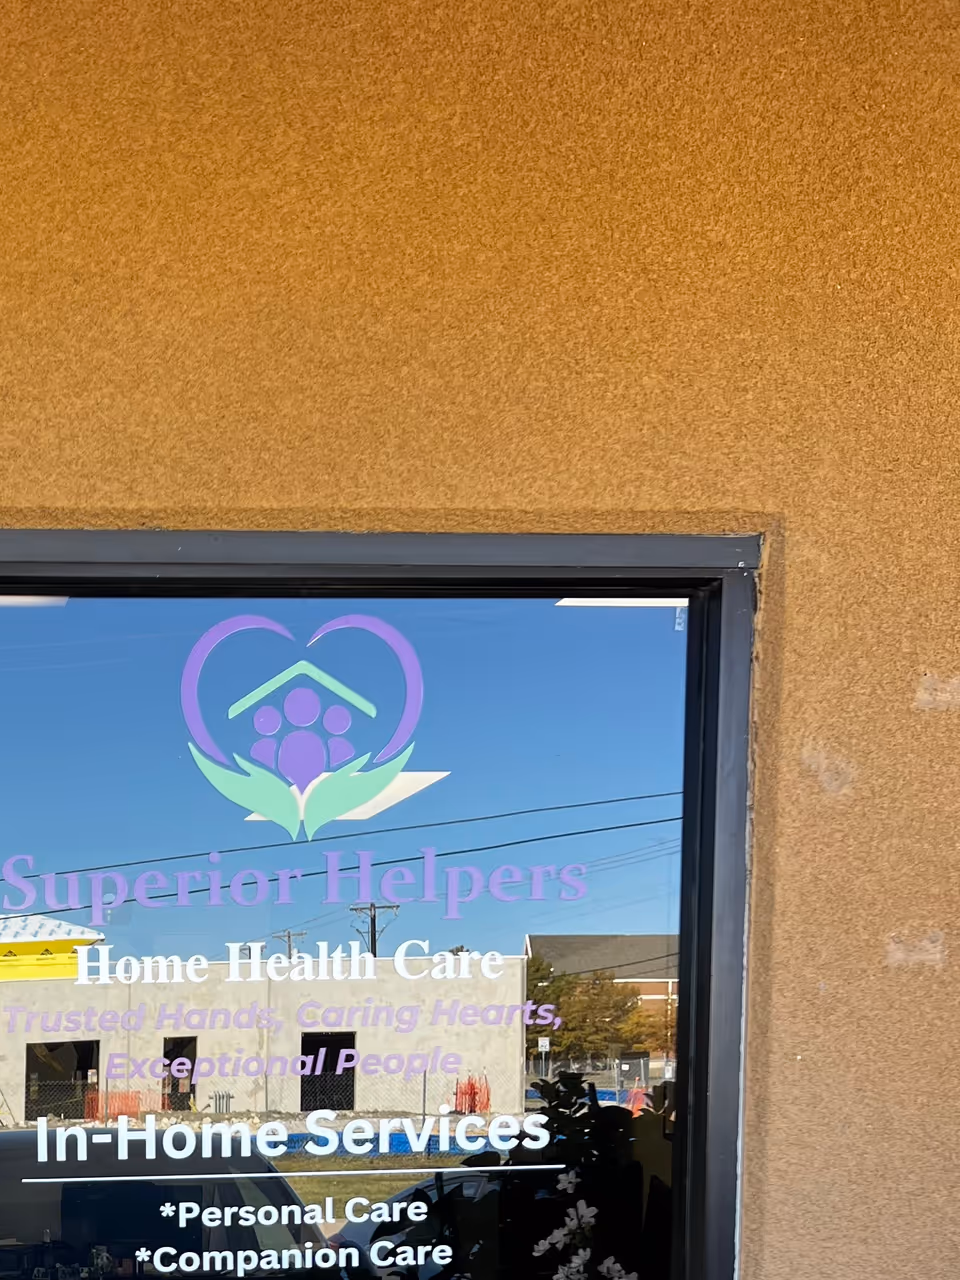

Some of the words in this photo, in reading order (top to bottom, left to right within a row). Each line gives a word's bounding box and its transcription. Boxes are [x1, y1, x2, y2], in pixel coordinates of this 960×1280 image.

[1, 850, 302, 928] Superior
[323, 846, 589, 919] Helpers
[74, 943, 209, 986] Home
[224, 940, 376, 983] Health
[393, 939, 504, 981] Care
[3, 1005, 147, 1035] Trusted
[156, 1003, 285, 1037] Hands,
[296, 1001, 421, 1037] Caring
[430, 999, 564, 1031] Hearts,
[105, 1047, 327, 1085] Exceptional
[335, 1047, 463, 1081] People
[36, 1114, 288, 1163] In-Home
[304, 1104, 551, 1157] Services
[344, 1195, 429, 1224] Care
[369, 1239, 453, 1268] Care
